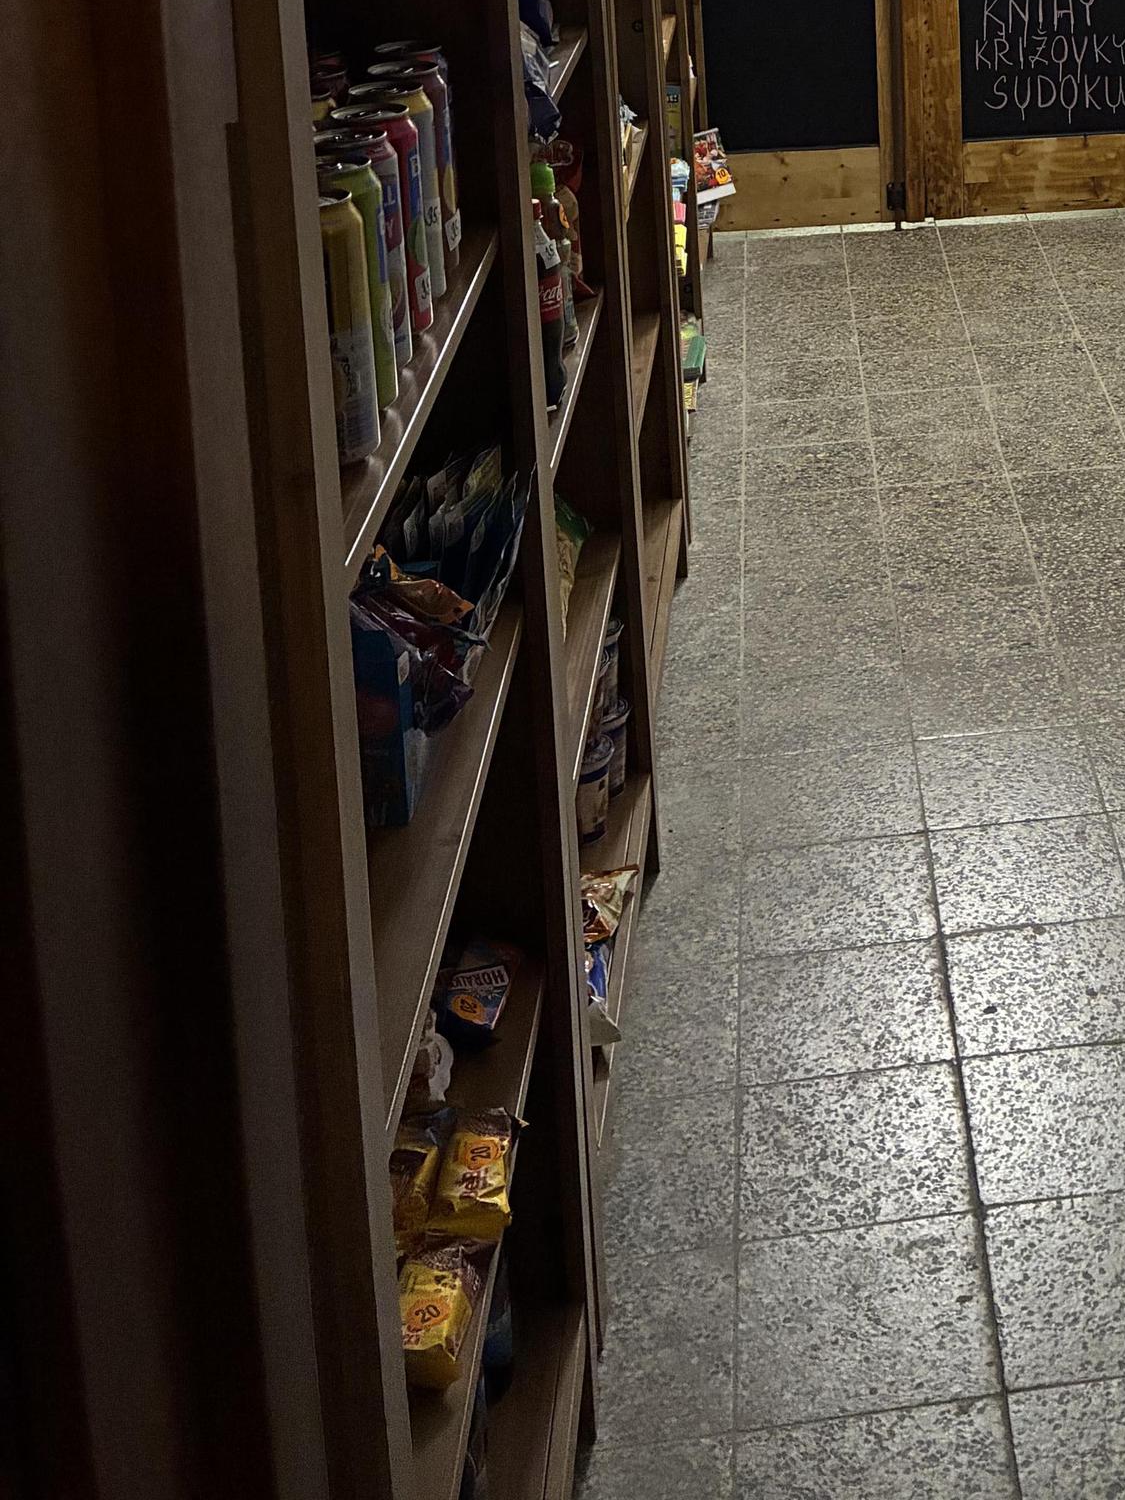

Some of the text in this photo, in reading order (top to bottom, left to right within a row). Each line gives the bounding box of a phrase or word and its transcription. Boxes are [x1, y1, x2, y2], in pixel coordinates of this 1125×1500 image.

[717, 169, 726, 179] 10
[470, 1145, 491, 1162] 20
[414, 1304, 441, 1324] 20
